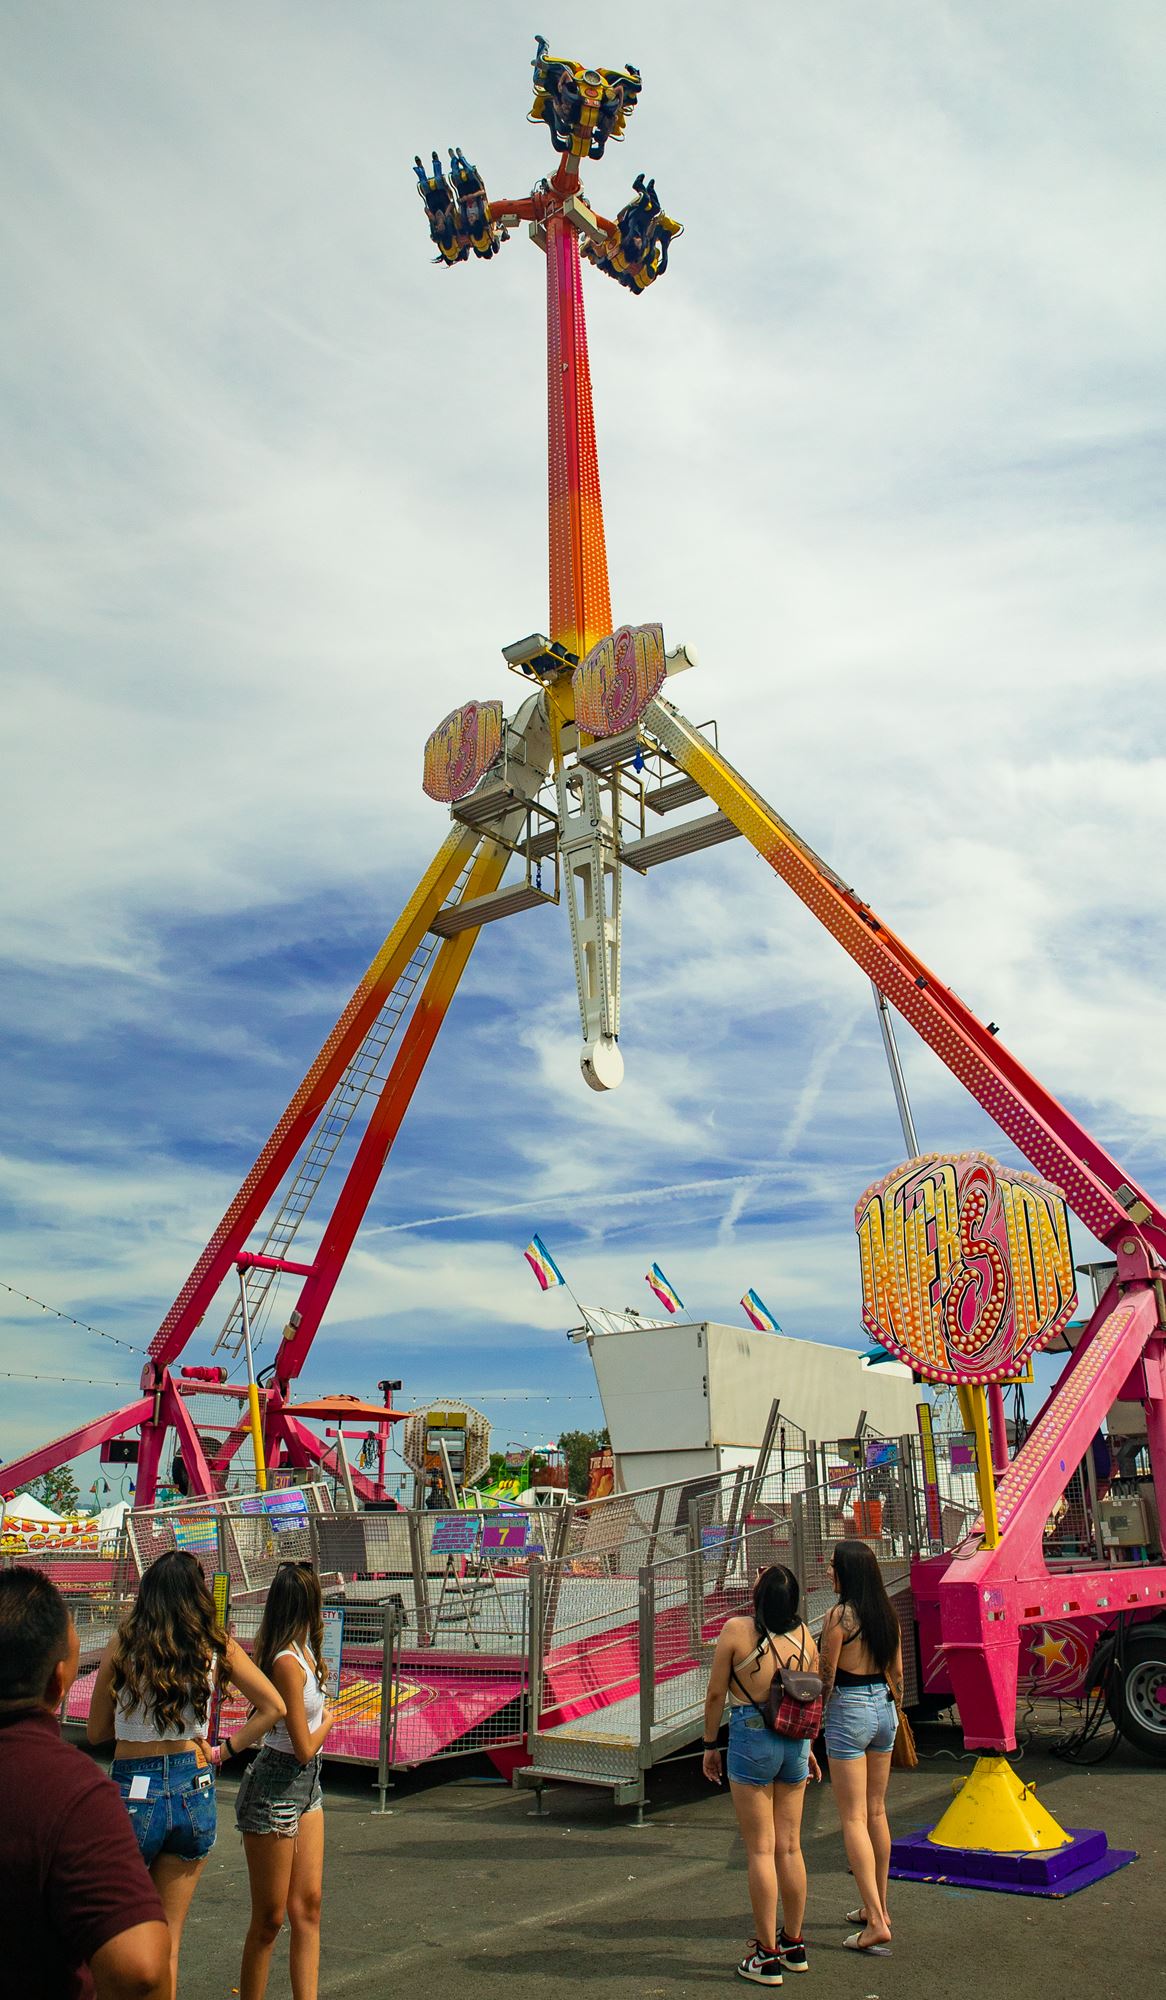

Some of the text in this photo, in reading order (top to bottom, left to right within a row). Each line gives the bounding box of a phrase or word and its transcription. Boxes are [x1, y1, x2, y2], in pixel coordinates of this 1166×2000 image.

[274, 1475, 291, 1489] EXIT
[2, 1515, 100, 1534] KETTLE
[28, 1533, 100, 1550] CORN
[499, 1528, 510, 1546] 7
[483, 1547, 523, 1555] COUPONS
[320, 1611, 336, 1619] ETY
